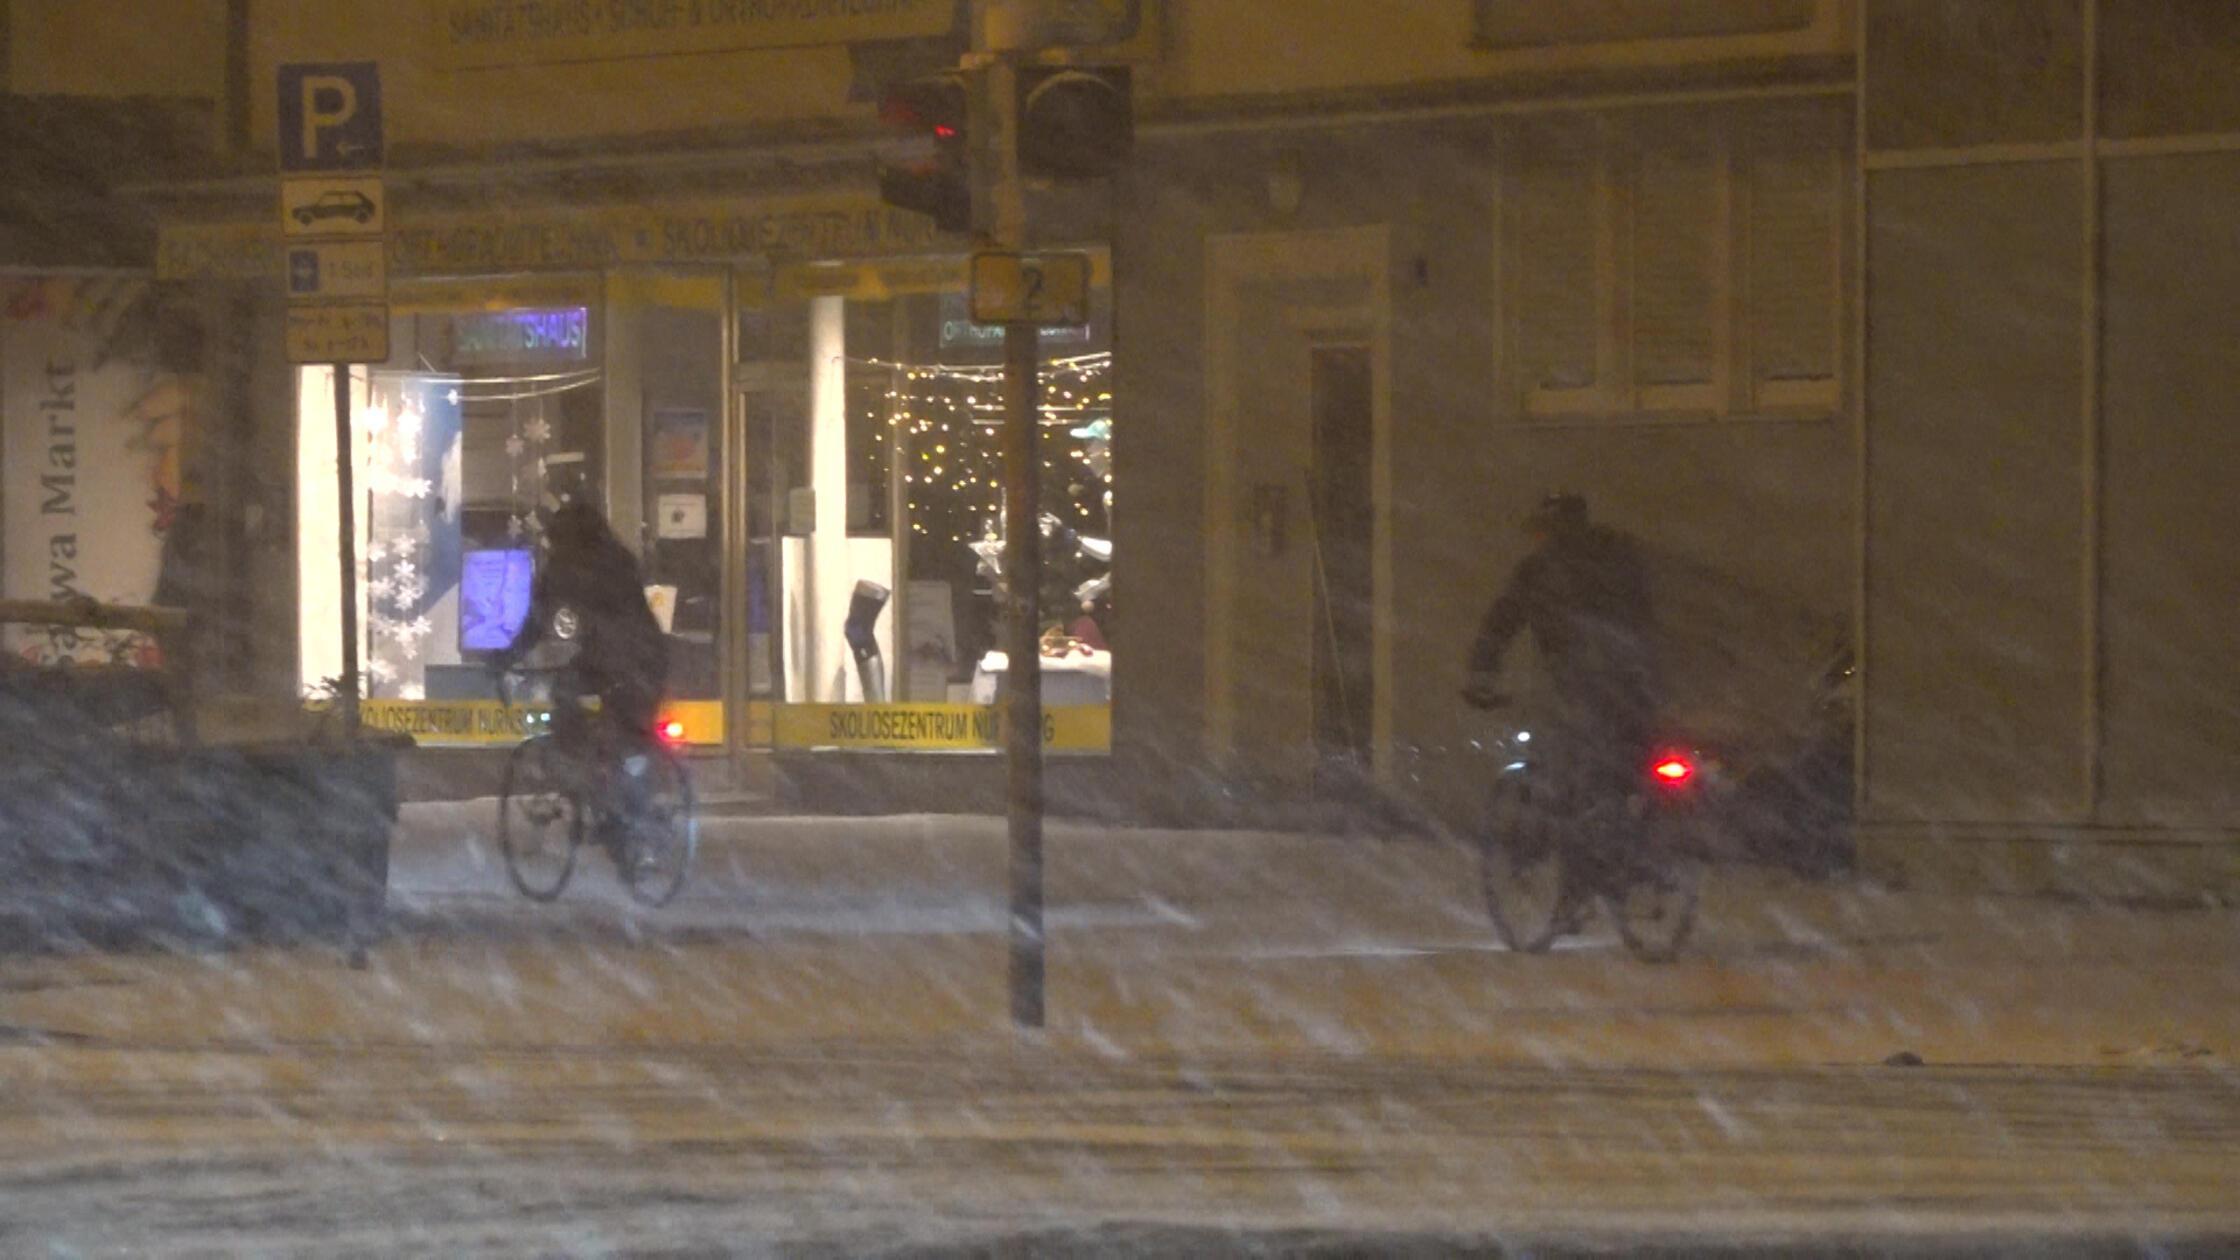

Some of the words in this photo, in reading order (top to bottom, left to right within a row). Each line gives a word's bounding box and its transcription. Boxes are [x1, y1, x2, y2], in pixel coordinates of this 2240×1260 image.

[303, 75, 357, 158] P
[40, 358, 76, 516] Markt
[829, 710, 968, 740] SKOLIOSEZENTRUM
